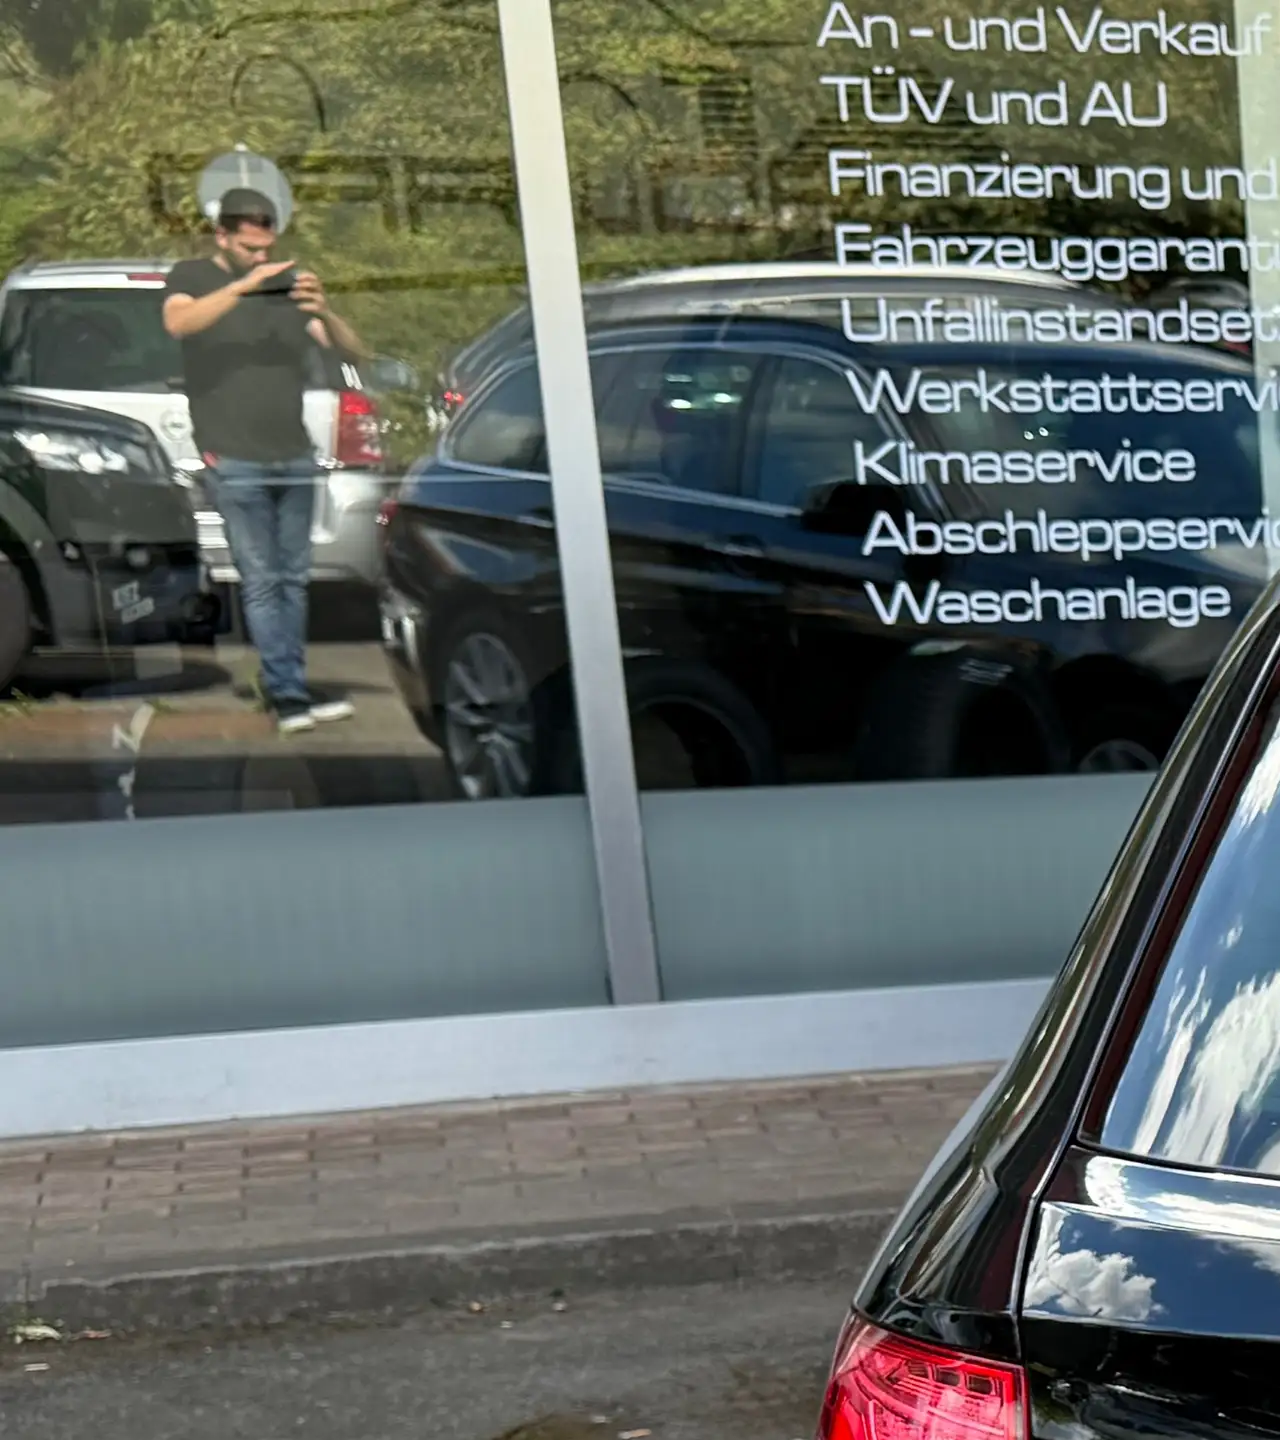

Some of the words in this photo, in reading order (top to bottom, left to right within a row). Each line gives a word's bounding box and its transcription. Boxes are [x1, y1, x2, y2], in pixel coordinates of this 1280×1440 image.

[1057, 6, 1274, 58] Verkauf
[820, 67, 954, 123] TÜV
[967, 82, 1068, 125] und
[1080, 83, 1168, 128] AU
[827, 151, 1172, 211] Finanzierung
[1182, 161, 1278, 202] und
[854, 439, 1196, 484] Klimaservice
[866, 578, 1231, 628] Waschanlage
